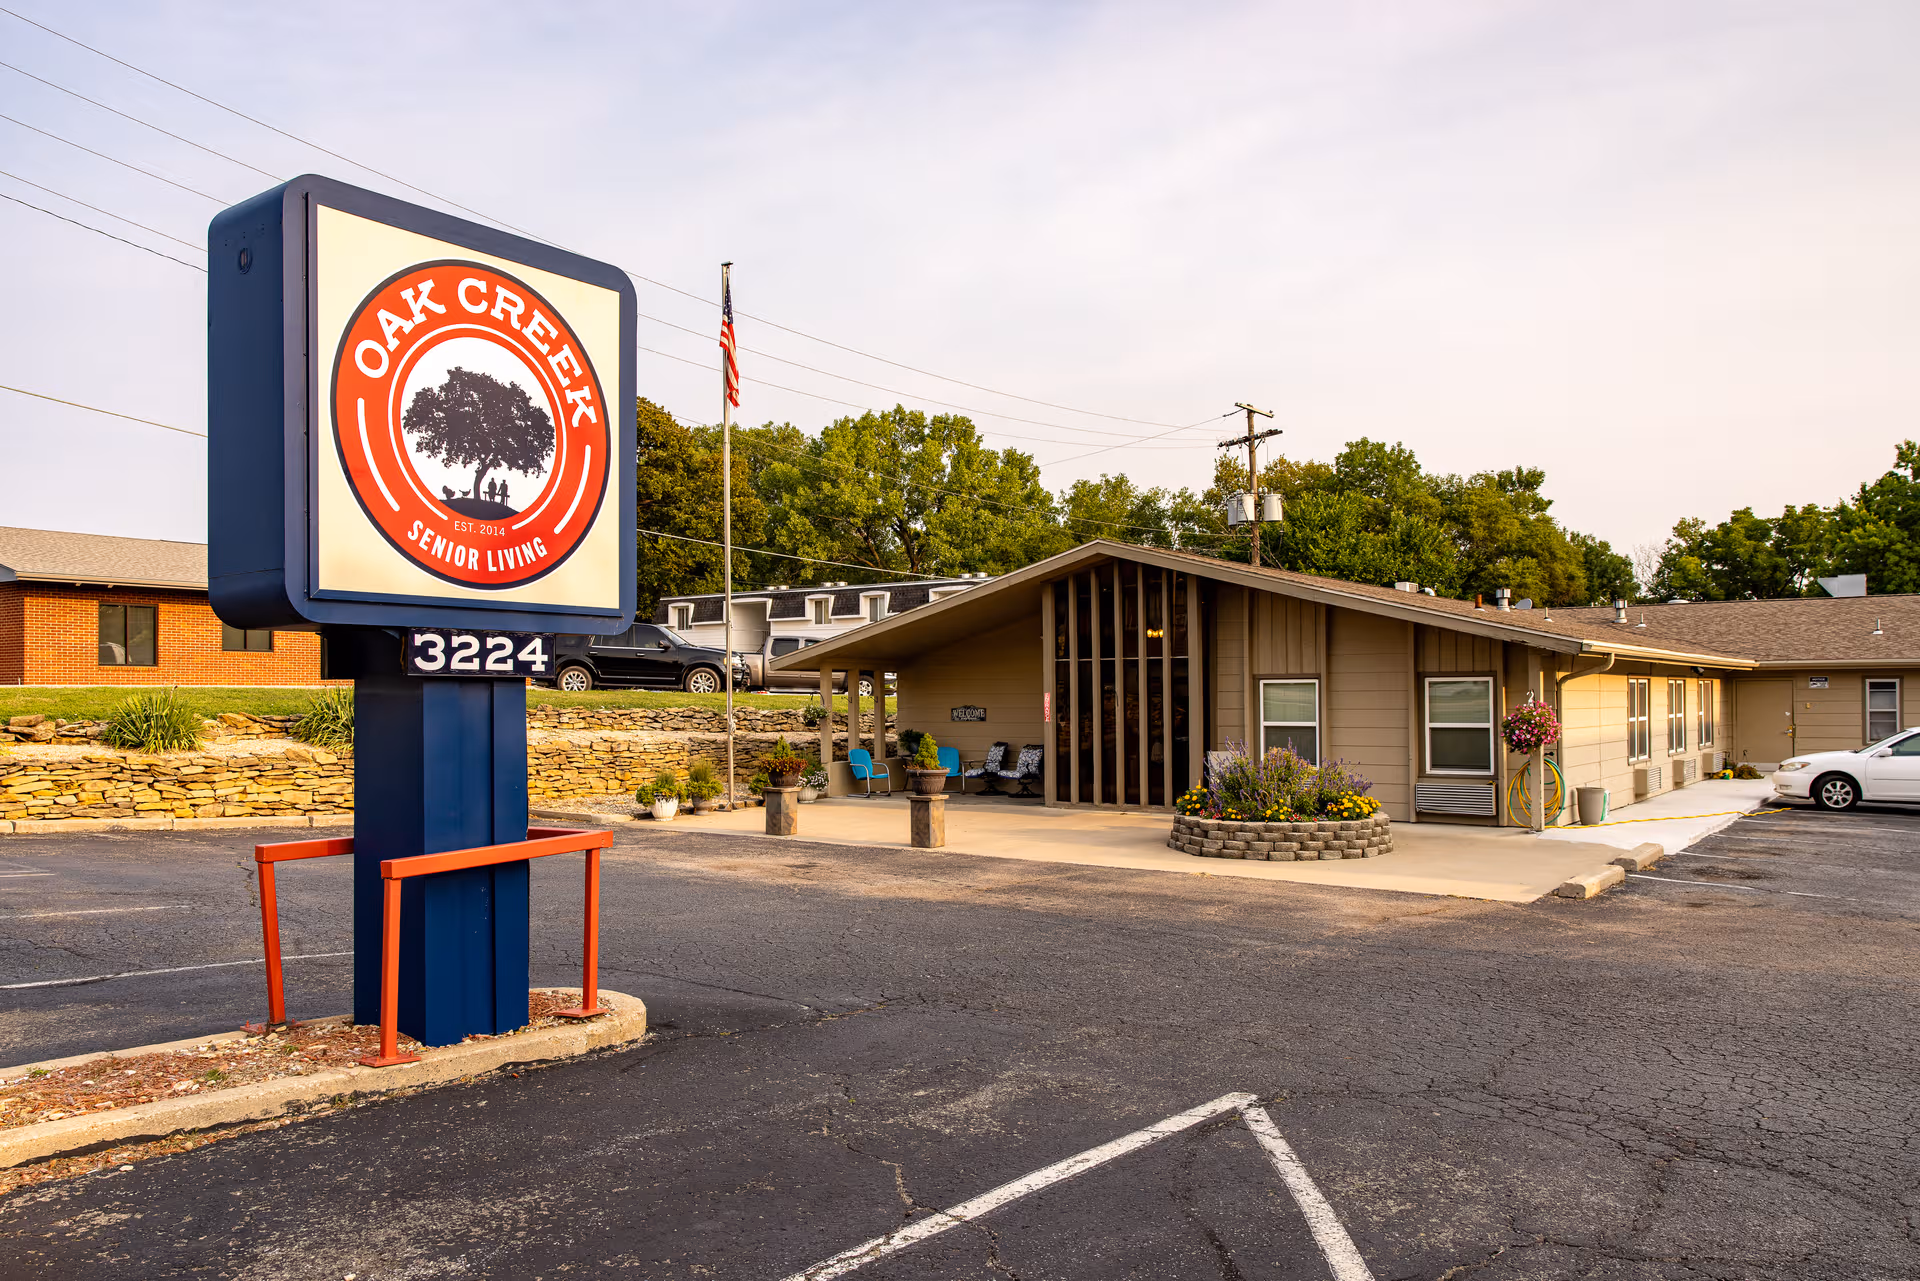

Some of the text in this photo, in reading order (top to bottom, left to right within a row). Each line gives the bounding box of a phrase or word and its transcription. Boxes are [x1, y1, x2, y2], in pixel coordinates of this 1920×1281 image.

[354, 277, 598, 428] OAK CREEK
[407, 519, 548, 572] SENIOR LIVING
[454, 520, 506, 537] EST. 2014
[414, 634, 549, 671] 3224
[952, 709, 985, 717] WELCOME
